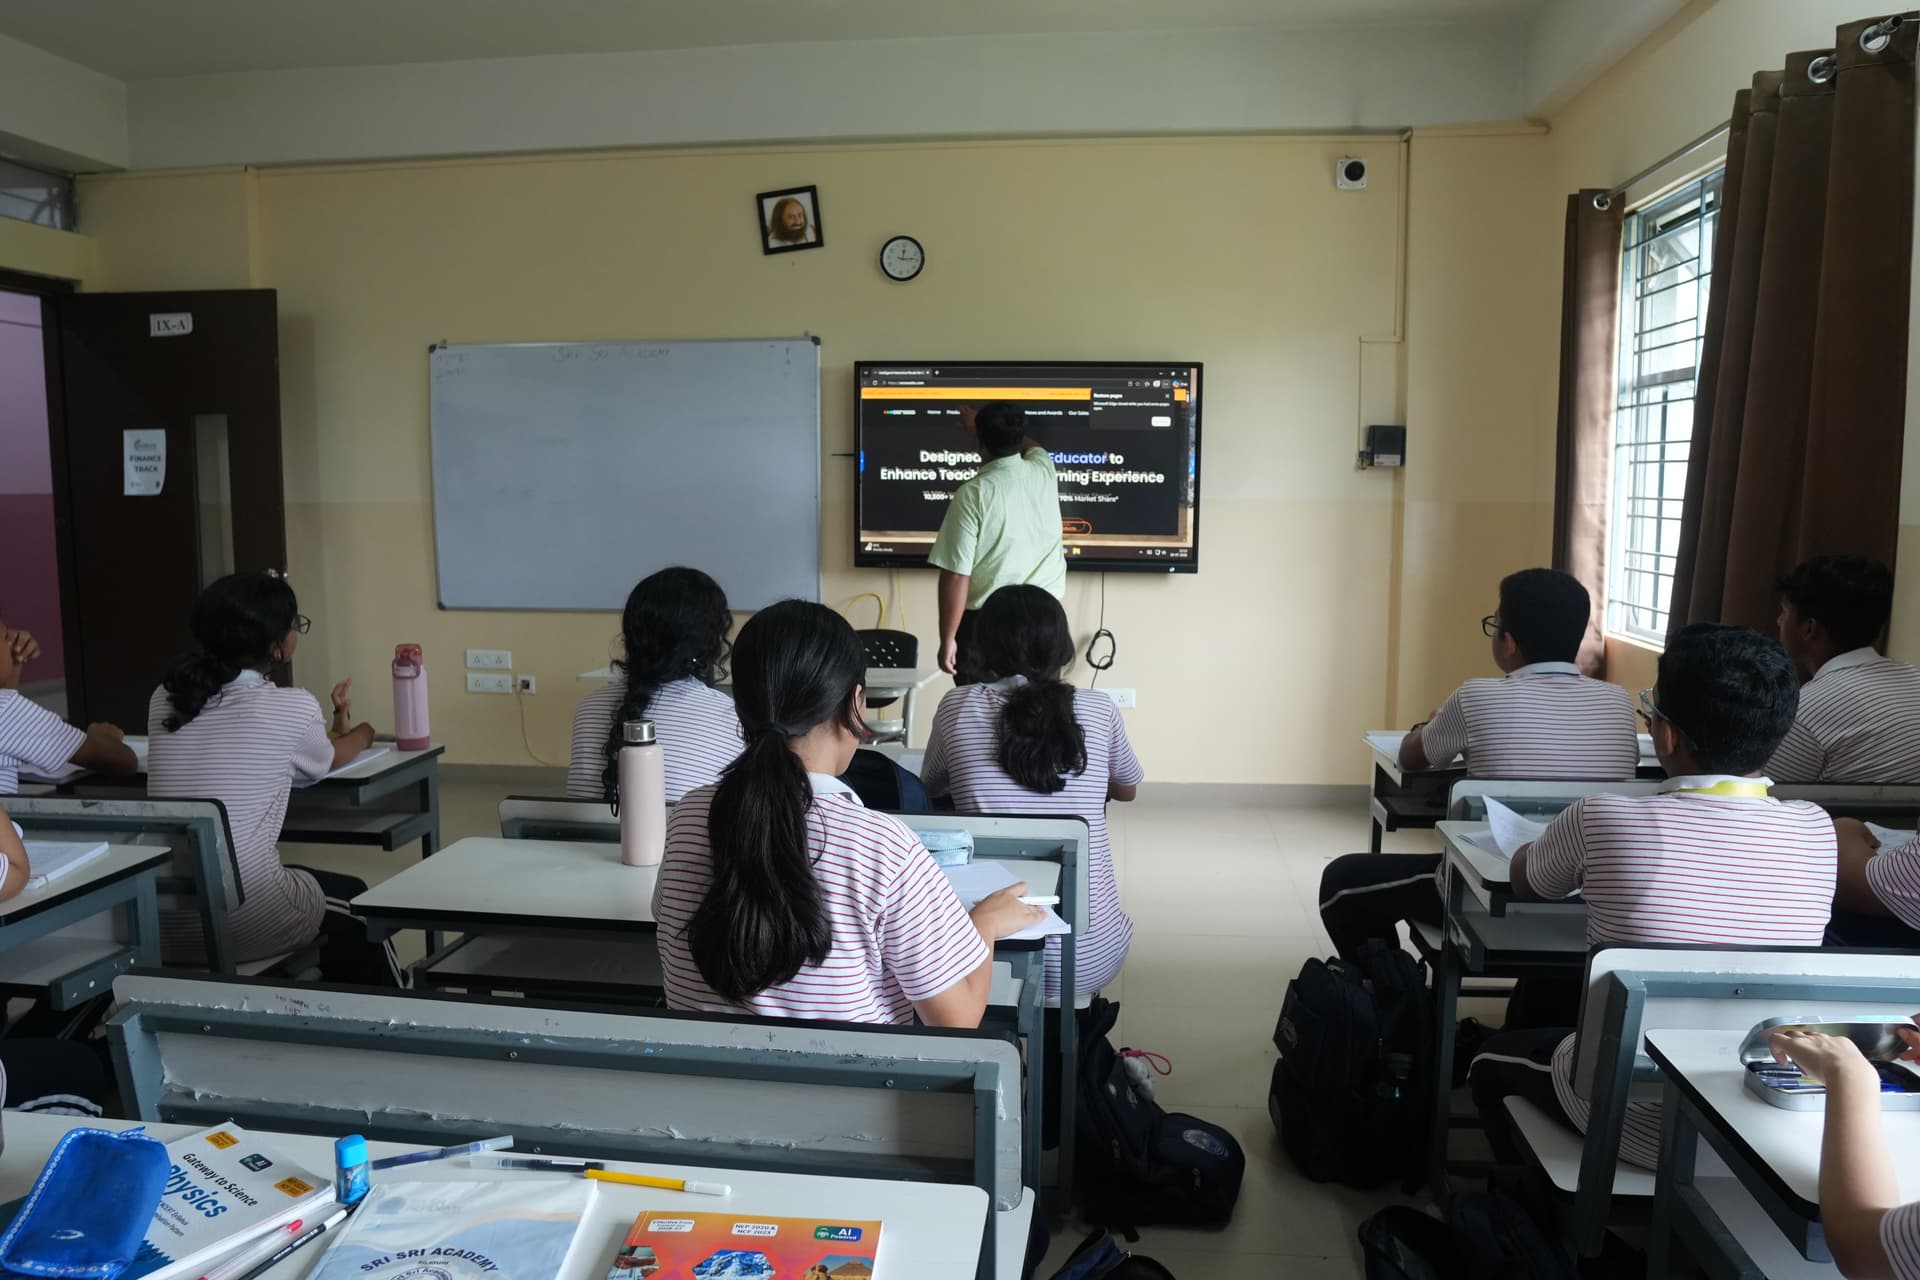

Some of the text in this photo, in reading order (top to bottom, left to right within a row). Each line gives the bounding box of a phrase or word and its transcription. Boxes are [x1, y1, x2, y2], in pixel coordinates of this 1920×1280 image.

[156, 319, 186, 331] IX-A
[129, 455, 161, 463] FINANCE
[1109, 453, 1124, 464] to
[134, 465, 158, 473] TRACK
[880, 467, 937, 481] Enhance
[1091, 471, 1165, 486] Experience
[182, 1152, 219, 1181] Gateway
[216, 1175, 228, 1188] to
[225, 1182, 258, 1207] Science
[830, 1233, 857, 1241] Powered
[838, 1228, 853, 1236] AI
[361, 1248, 499, 1272] SRI SRI ACADEMY
